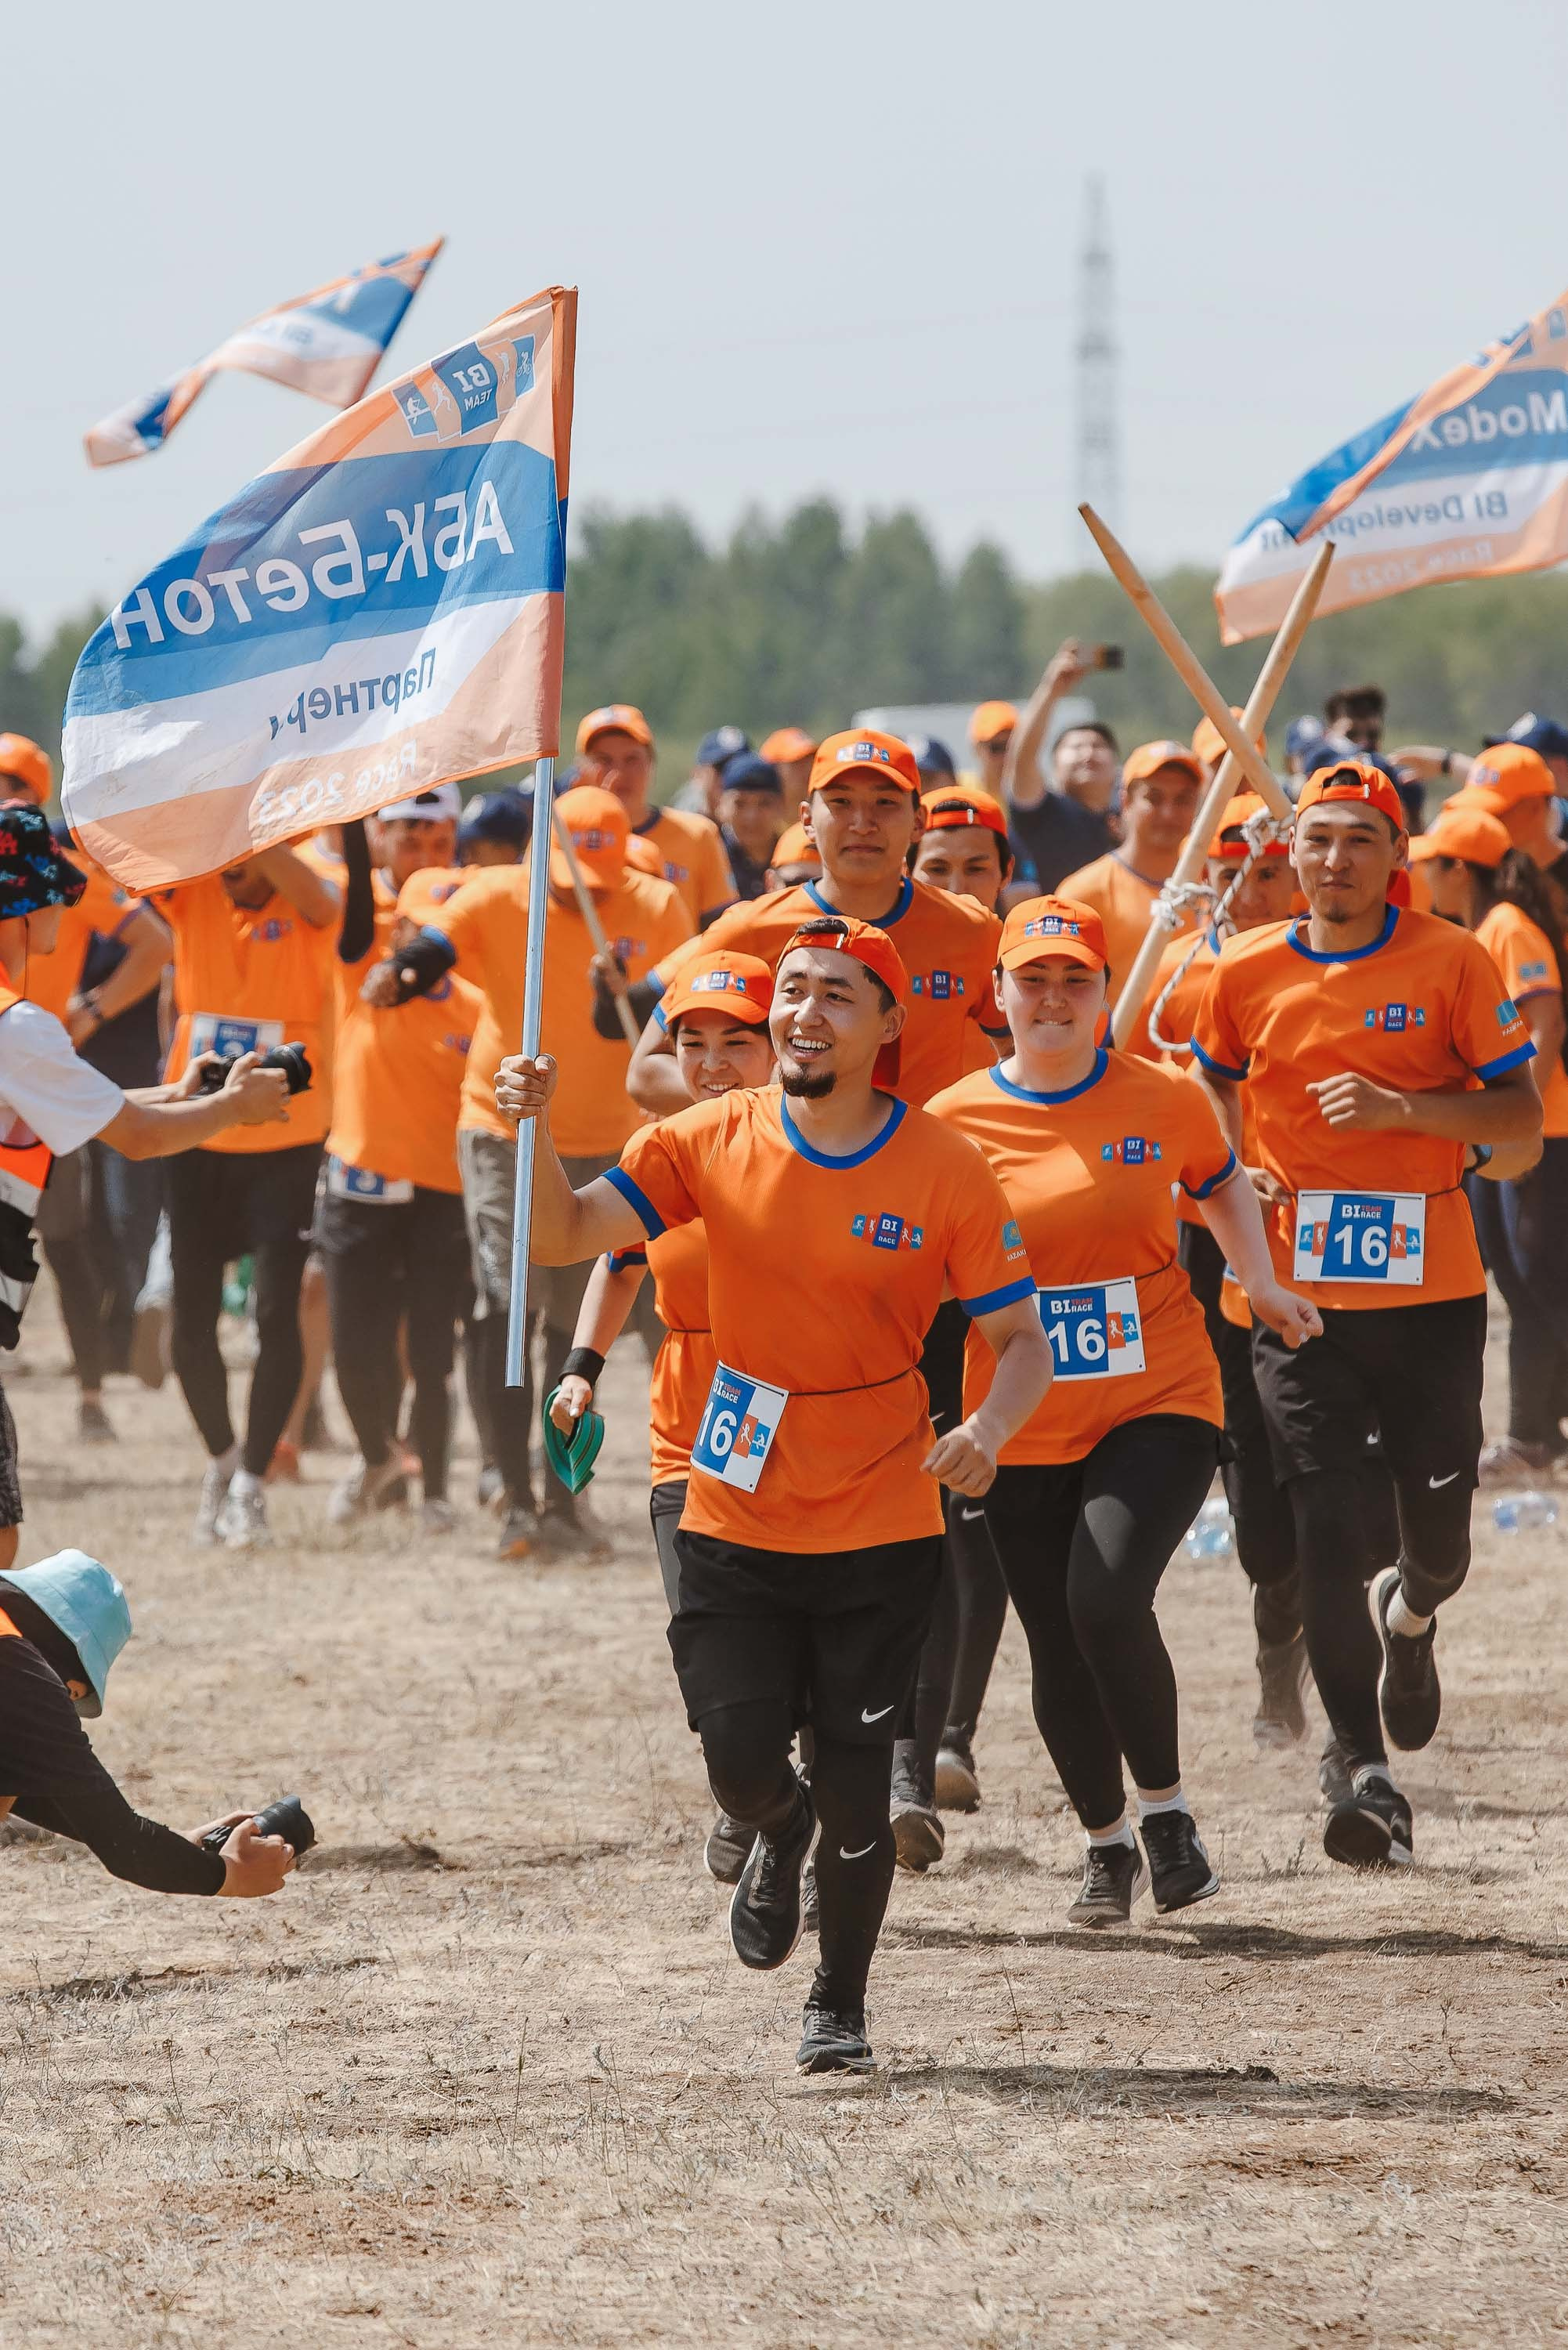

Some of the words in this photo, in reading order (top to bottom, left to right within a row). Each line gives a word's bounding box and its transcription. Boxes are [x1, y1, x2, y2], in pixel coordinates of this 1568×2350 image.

[935, 974, 946, 984] BI
[1389, 1007, 1403, 1017] BI
[1342, 1204, 1360, 1219] BI
[1360, 1211, 1381, 1220] RACE
[881, 1219, 898, 1231] BI
[878, 1235, 895, 1245] RACE
[1335, 1224, 1388, 1267] 16
[1050, 1299, 1071, 1314] BI
[1071, 1303, 1093, 1313] RACE
[1048, 1318, 1106, 1363] 16
[712, 1377, 724, 1397] BI
[721, 1391, 739, 1404] RACE
[699, 1401, 738, 1457] 16
